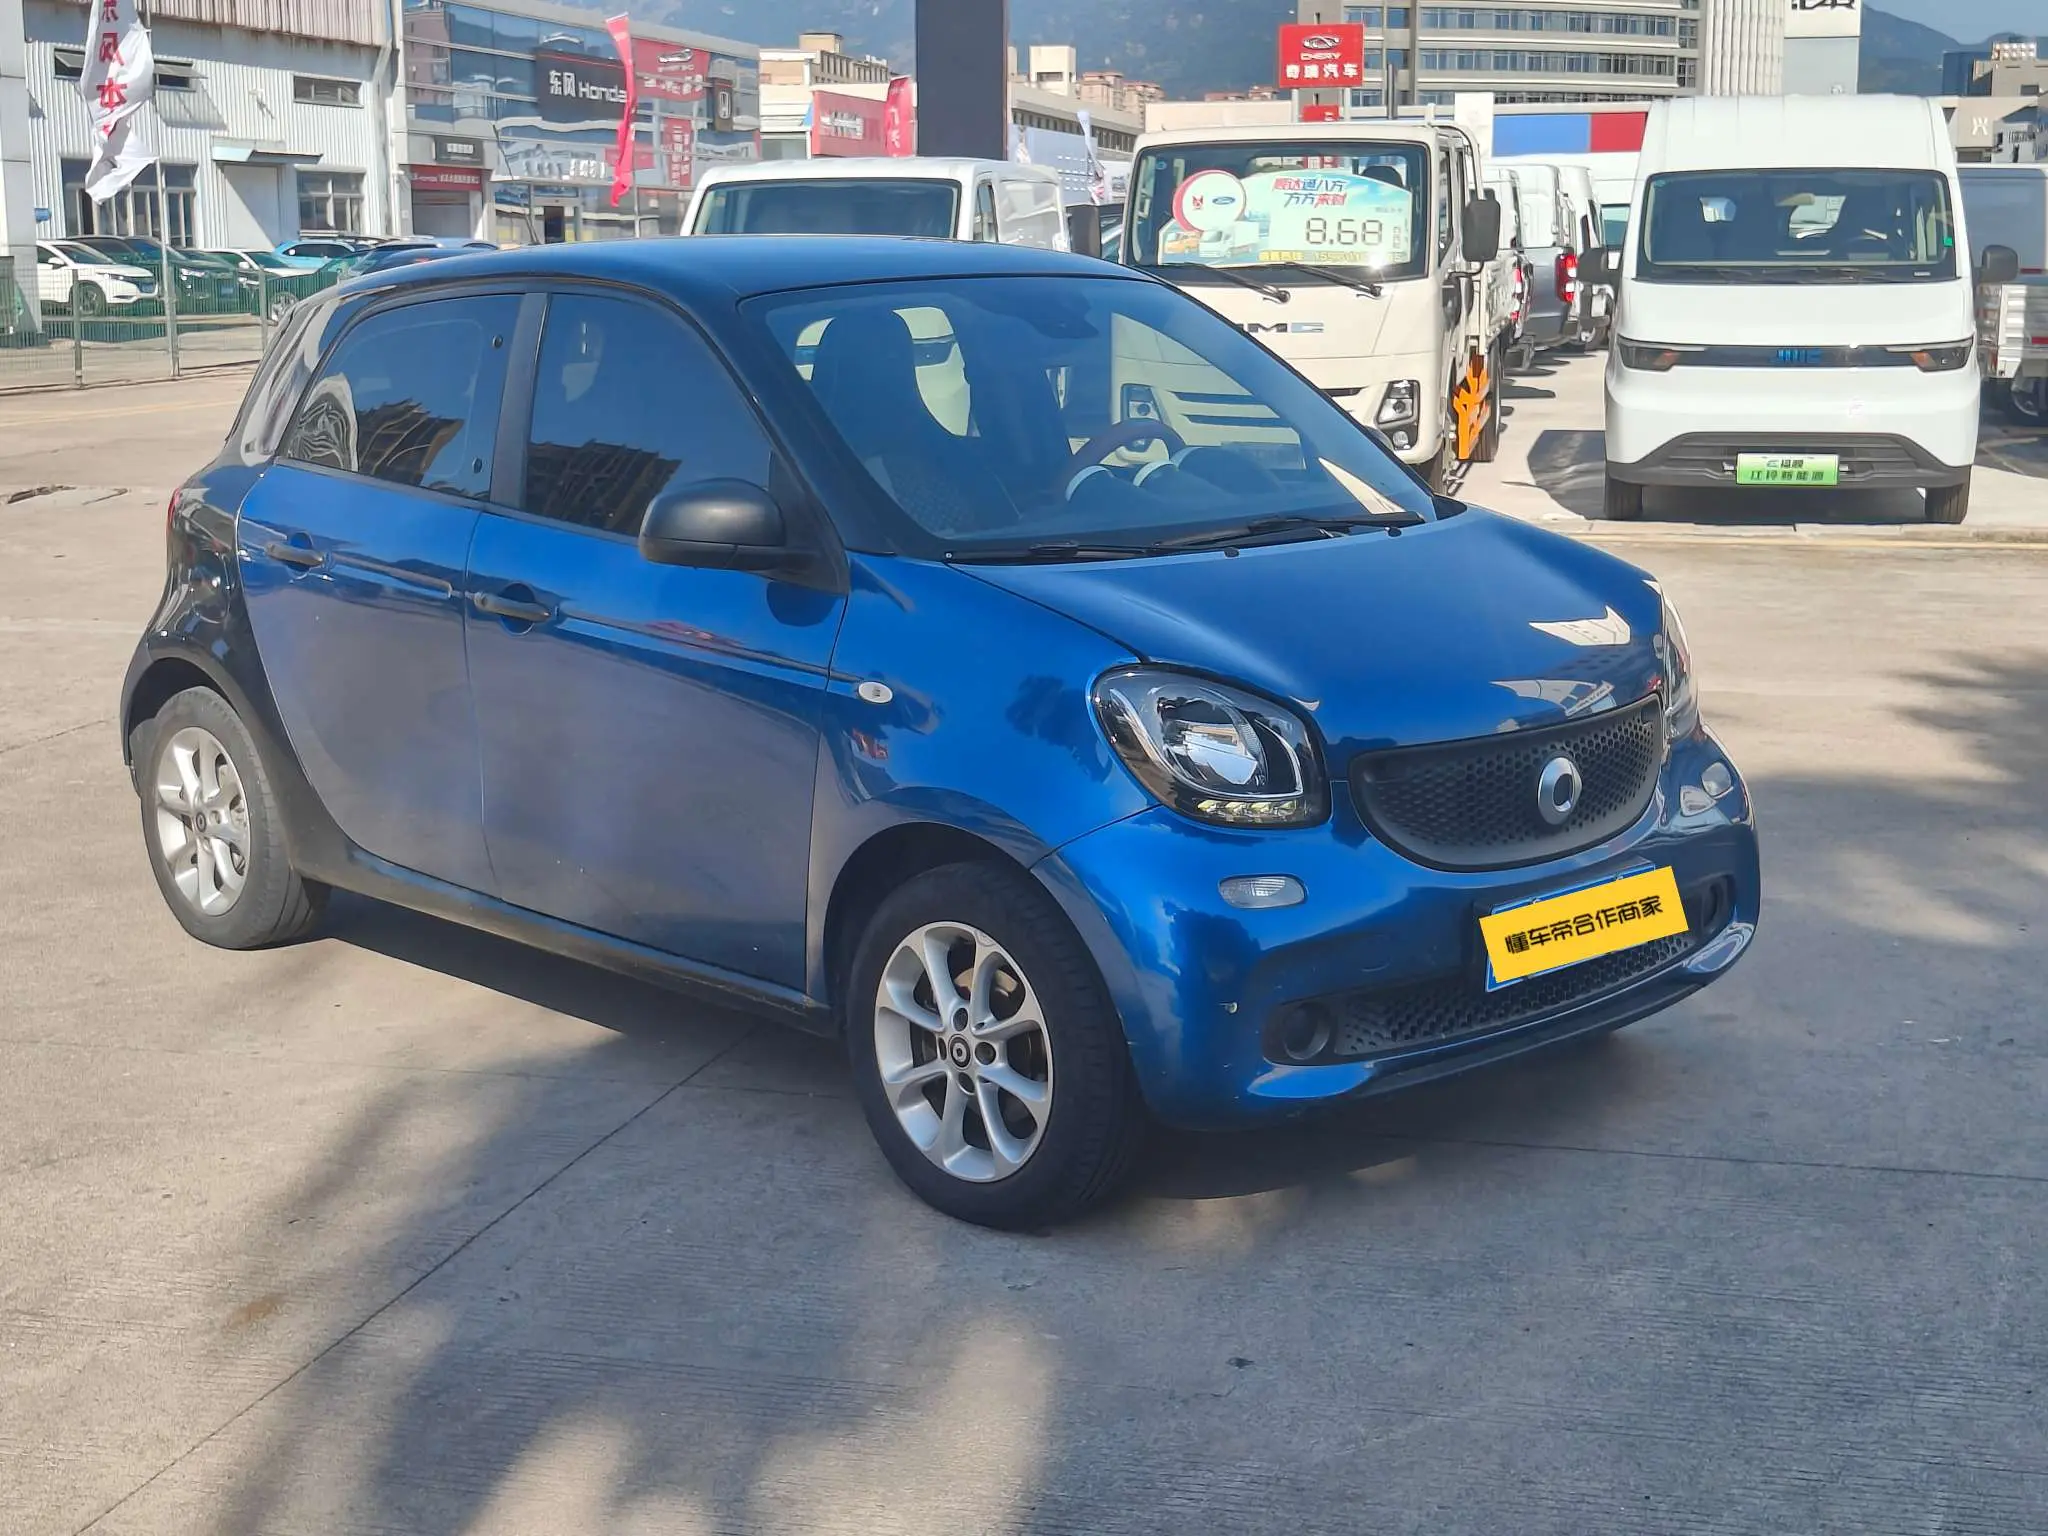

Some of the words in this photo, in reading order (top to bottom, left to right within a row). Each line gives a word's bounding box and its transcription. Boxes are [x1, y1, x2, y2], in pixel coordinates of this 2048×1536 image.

[549, 69, 576, 97] 东风
[1306, 217, 1383, 245] 8.68
[1236, 323, 1324, 333] MC
